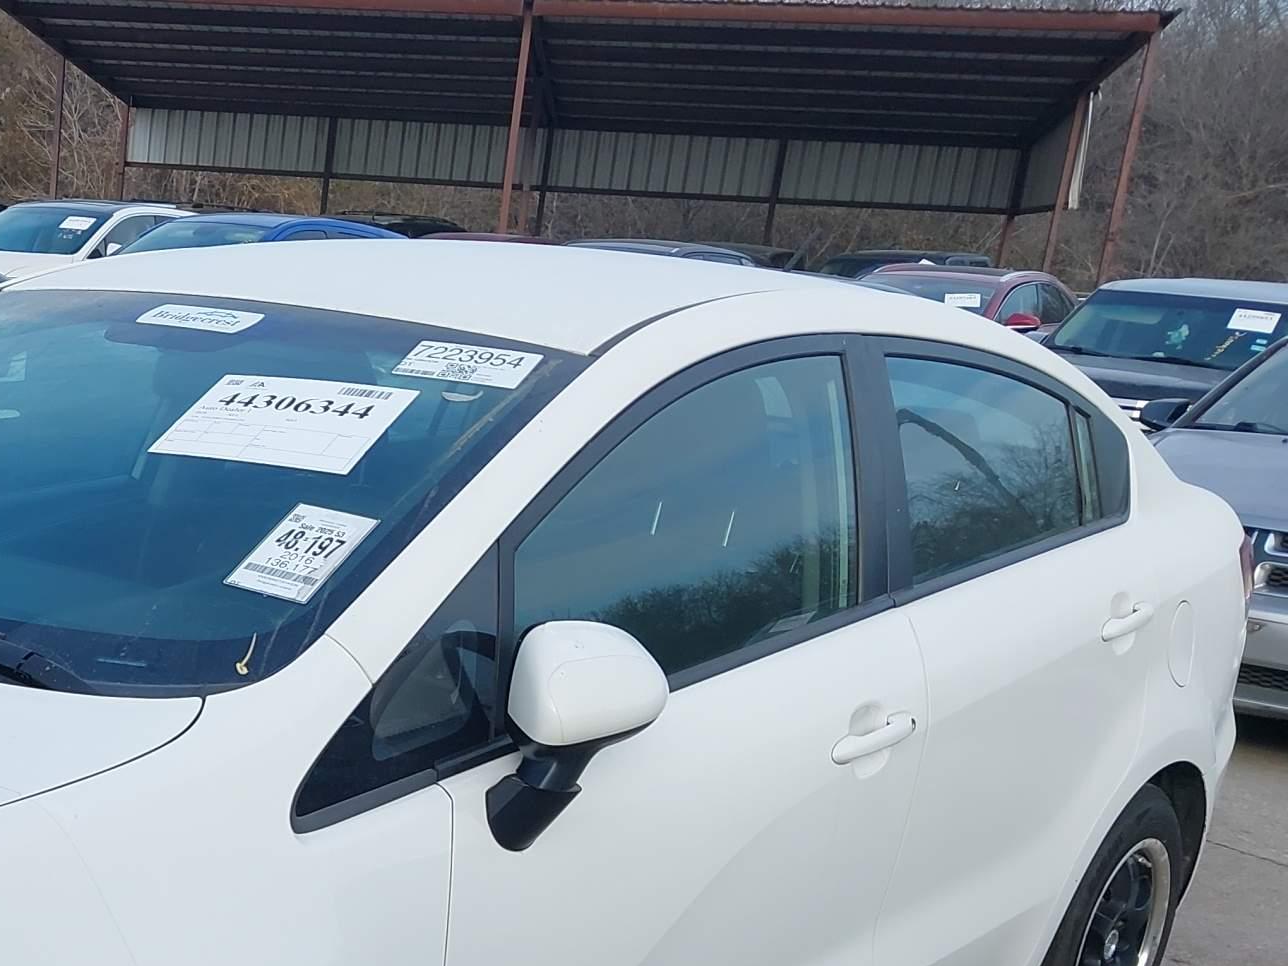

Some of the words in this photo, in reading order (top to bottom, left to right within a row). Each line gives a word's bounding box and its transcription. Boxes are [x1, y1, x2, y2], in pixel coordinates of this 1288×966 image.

[152, 310, 241, 327] Bridgecrest
[413, 344, 526, 369] 7223954
[218, 392, 376, 419] 44306344
[279, 551, 315, 565] 2016
